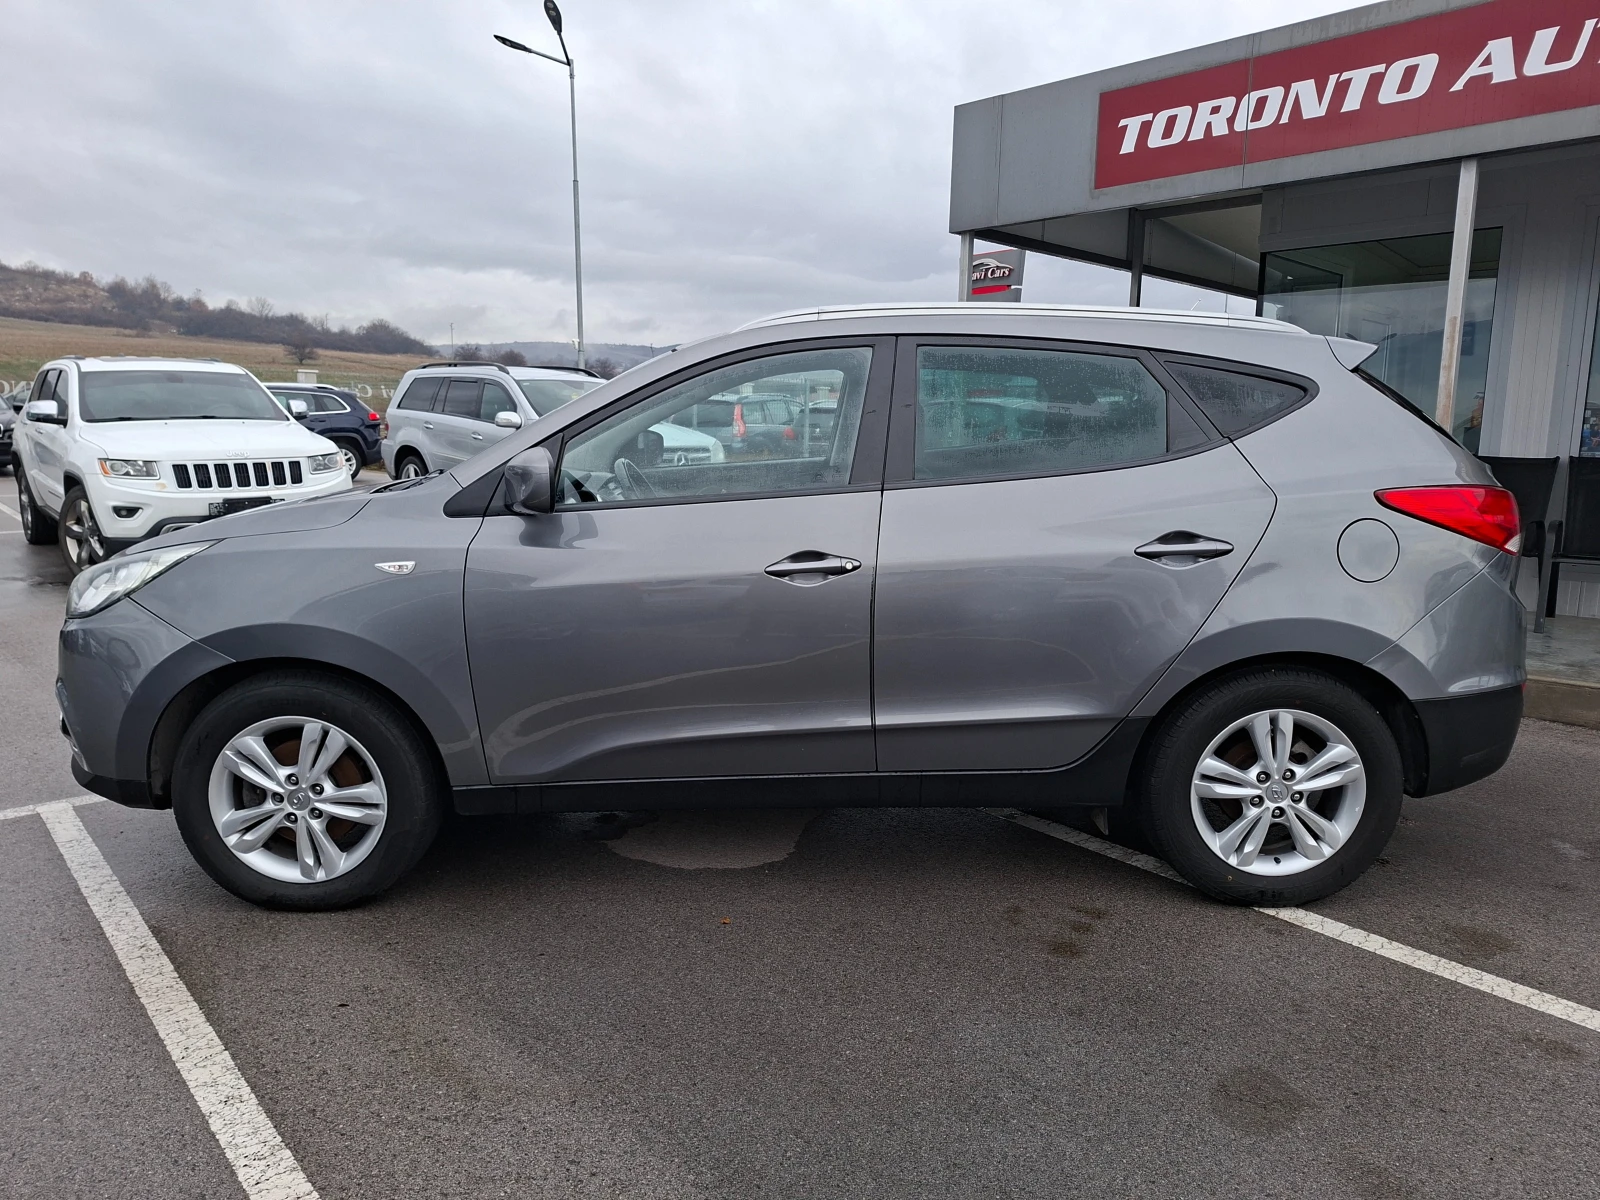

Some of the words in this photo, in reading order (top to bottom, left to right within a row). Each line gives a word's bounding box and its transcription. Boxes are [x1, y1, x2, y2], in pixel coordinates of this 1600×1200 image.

[1117, 52, 1440, 155] TORONTO
[1448, 18, 1600, 92] AU
[988, 267, 1009, 278] Cars
[226, 450, 250, 459] Jeep
